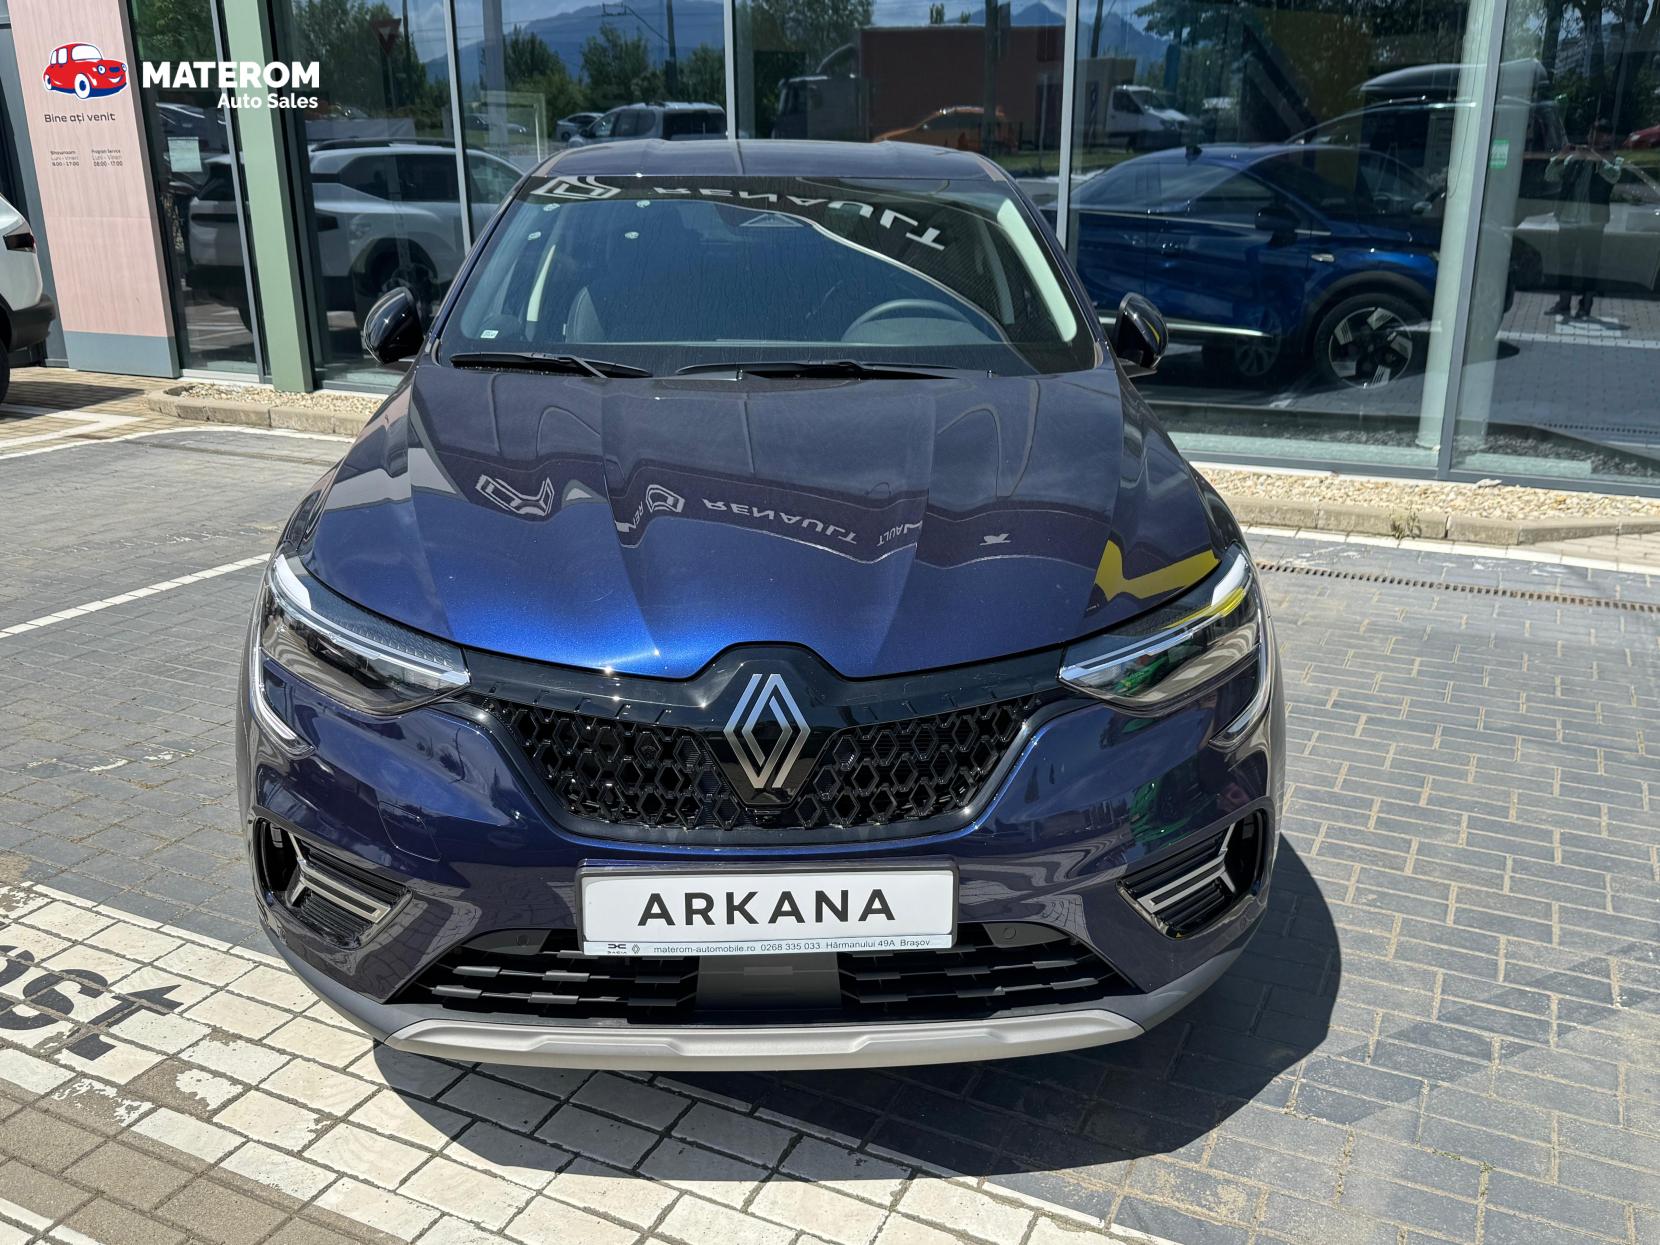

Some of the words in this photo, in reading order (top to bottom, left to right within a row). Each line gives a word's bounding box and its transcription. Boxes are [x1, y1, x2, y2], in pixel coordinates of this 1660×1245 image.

[44, 113, 67, 123] Bine
[86, 112, 116, 122] venit
[637, 888, 896, 927] ARKANA
[653, 944, 756, 954] materom-automobile.ro
[760, 943, 783, 952] 0268
[785, 942, 802, 951] 335
